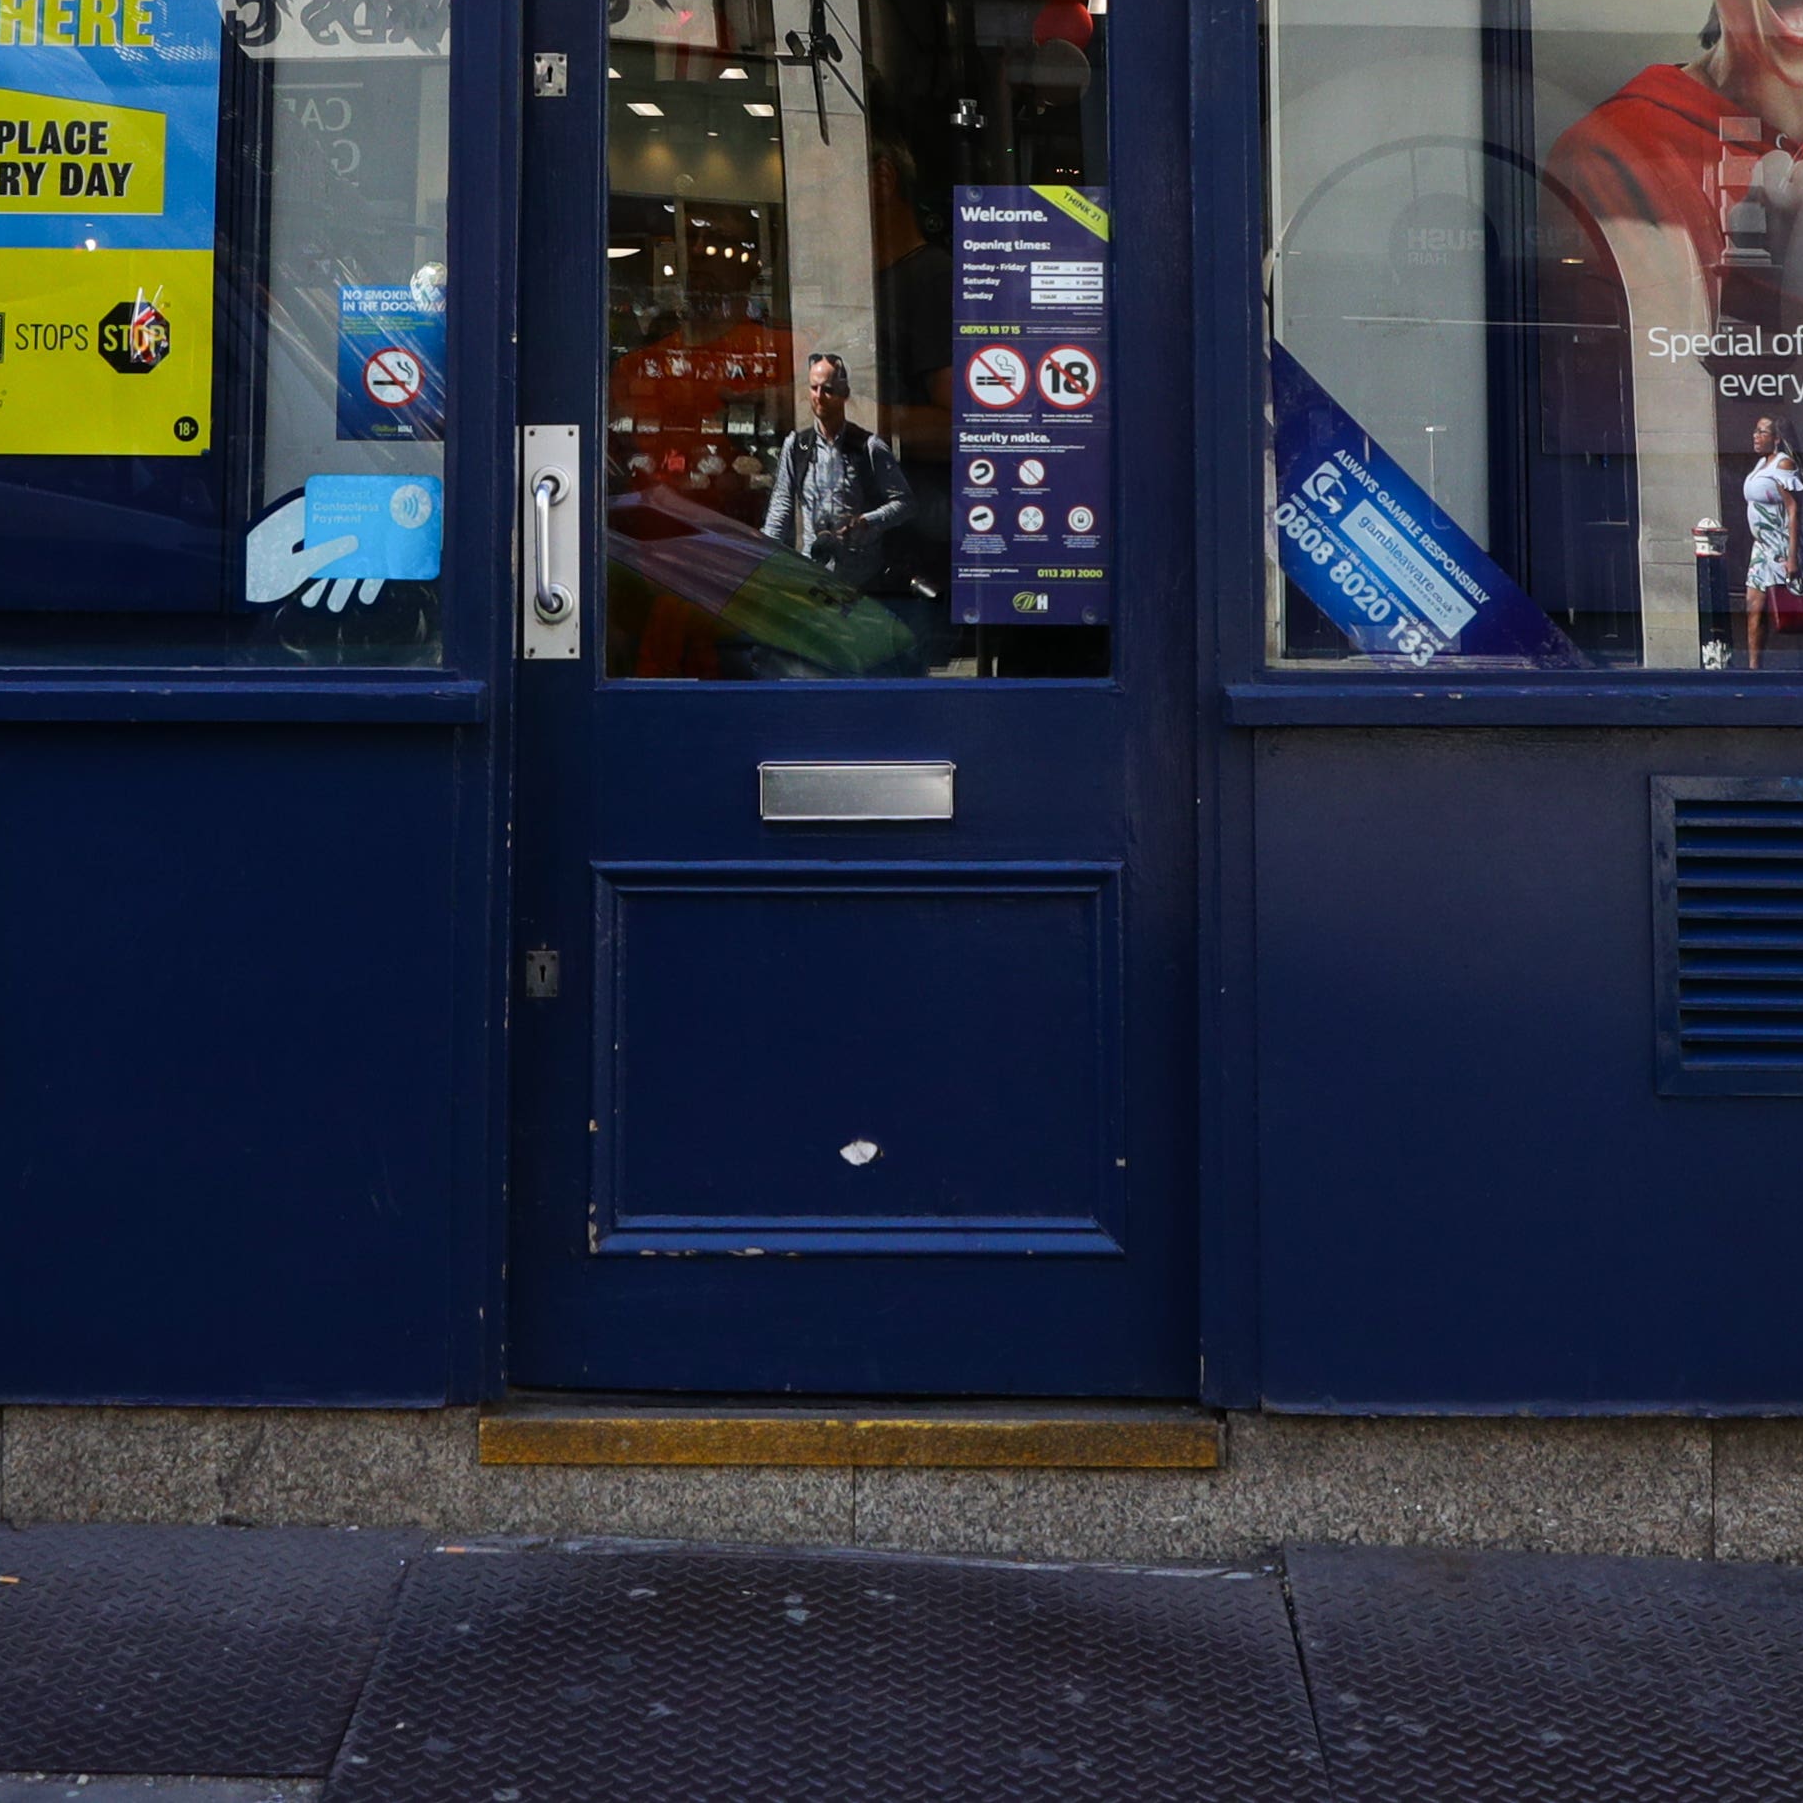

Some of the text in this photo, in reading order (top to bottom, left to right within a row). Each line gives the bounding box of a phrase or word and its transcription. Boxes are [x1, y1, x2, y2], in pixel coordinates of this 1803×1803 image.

[59, 162, 135, 197] DAY
[1063, 191, 1091, 215] THINK
[961, 206, 1048, 223] Welcome.
[963, 240, 1051, 252] Opening times:
[963, 264, 996, 273] Monday
[1000, 263, 1027, 273] Friday
[963, 277, 1001, 287] Saturday
[342, 289, 420, 301] NO SMOKIN
[963, 292, 994, 301] Sunday
[342, 301, 355, 312] IN
[358, 301, 379, 312] THE
[15, 323, 89, 351] STOPS
[103, 324, 168, 353] STOP
[1647, 326, 1762, 362] Special
[1046, 361, 1090, 395] 18
[959, 432, 1050, 445] Security notice.
[1333, 449, 1490, 605] ALWAYS GAMBLE RESPONSIBLY
[1037, 569, 1103, 579] 0113 291 2000
[1273, 502, 1435, 667] 0808 8020 133
